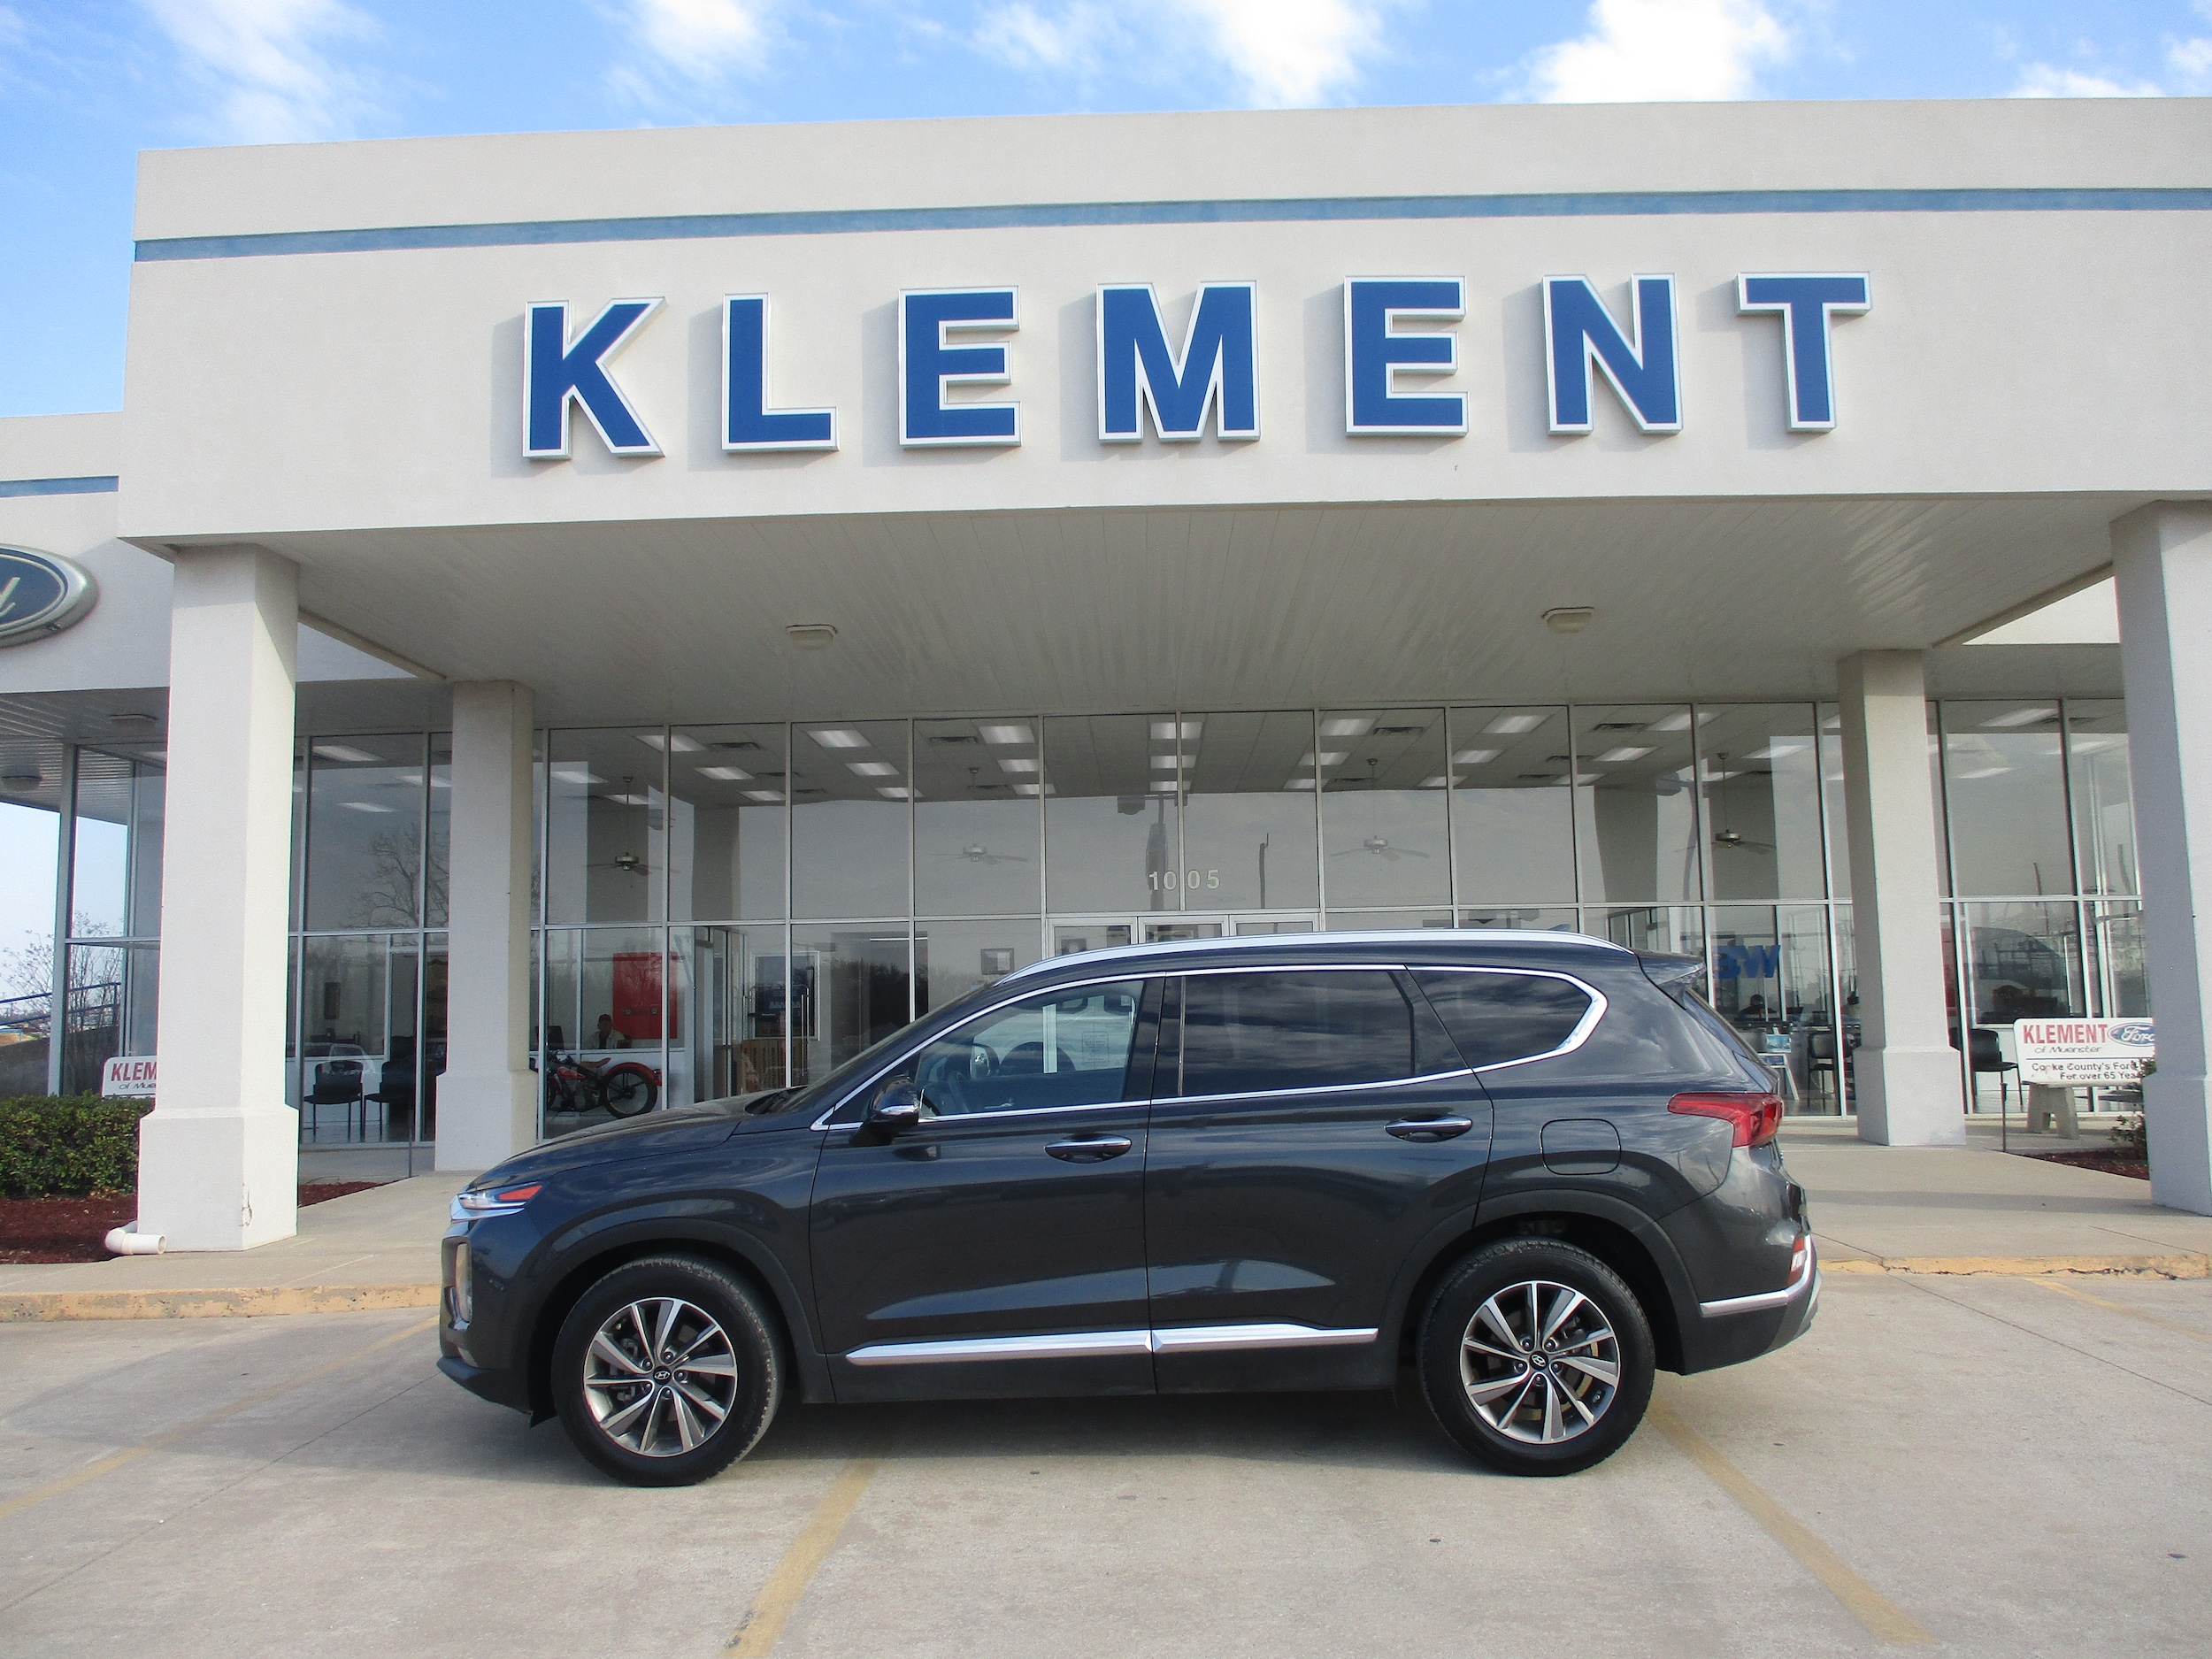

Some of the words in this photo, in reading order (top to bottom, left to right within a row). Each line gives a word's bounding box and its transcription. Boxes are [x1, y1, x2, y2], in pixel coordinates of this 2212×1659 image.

[521, 272, 1873, 461] KLEMENT
[1148, 869, 1220, 891] 1005
[2023, 1024, 2108, 1044] KLEMENT
[111, 1062, 157, 1081] KLEM
[2032, 1063, 2063, 1071] Coke
[2066, 1062, 2110, 1072] County's
[2117, 1071, 2141, 1079] Yea
